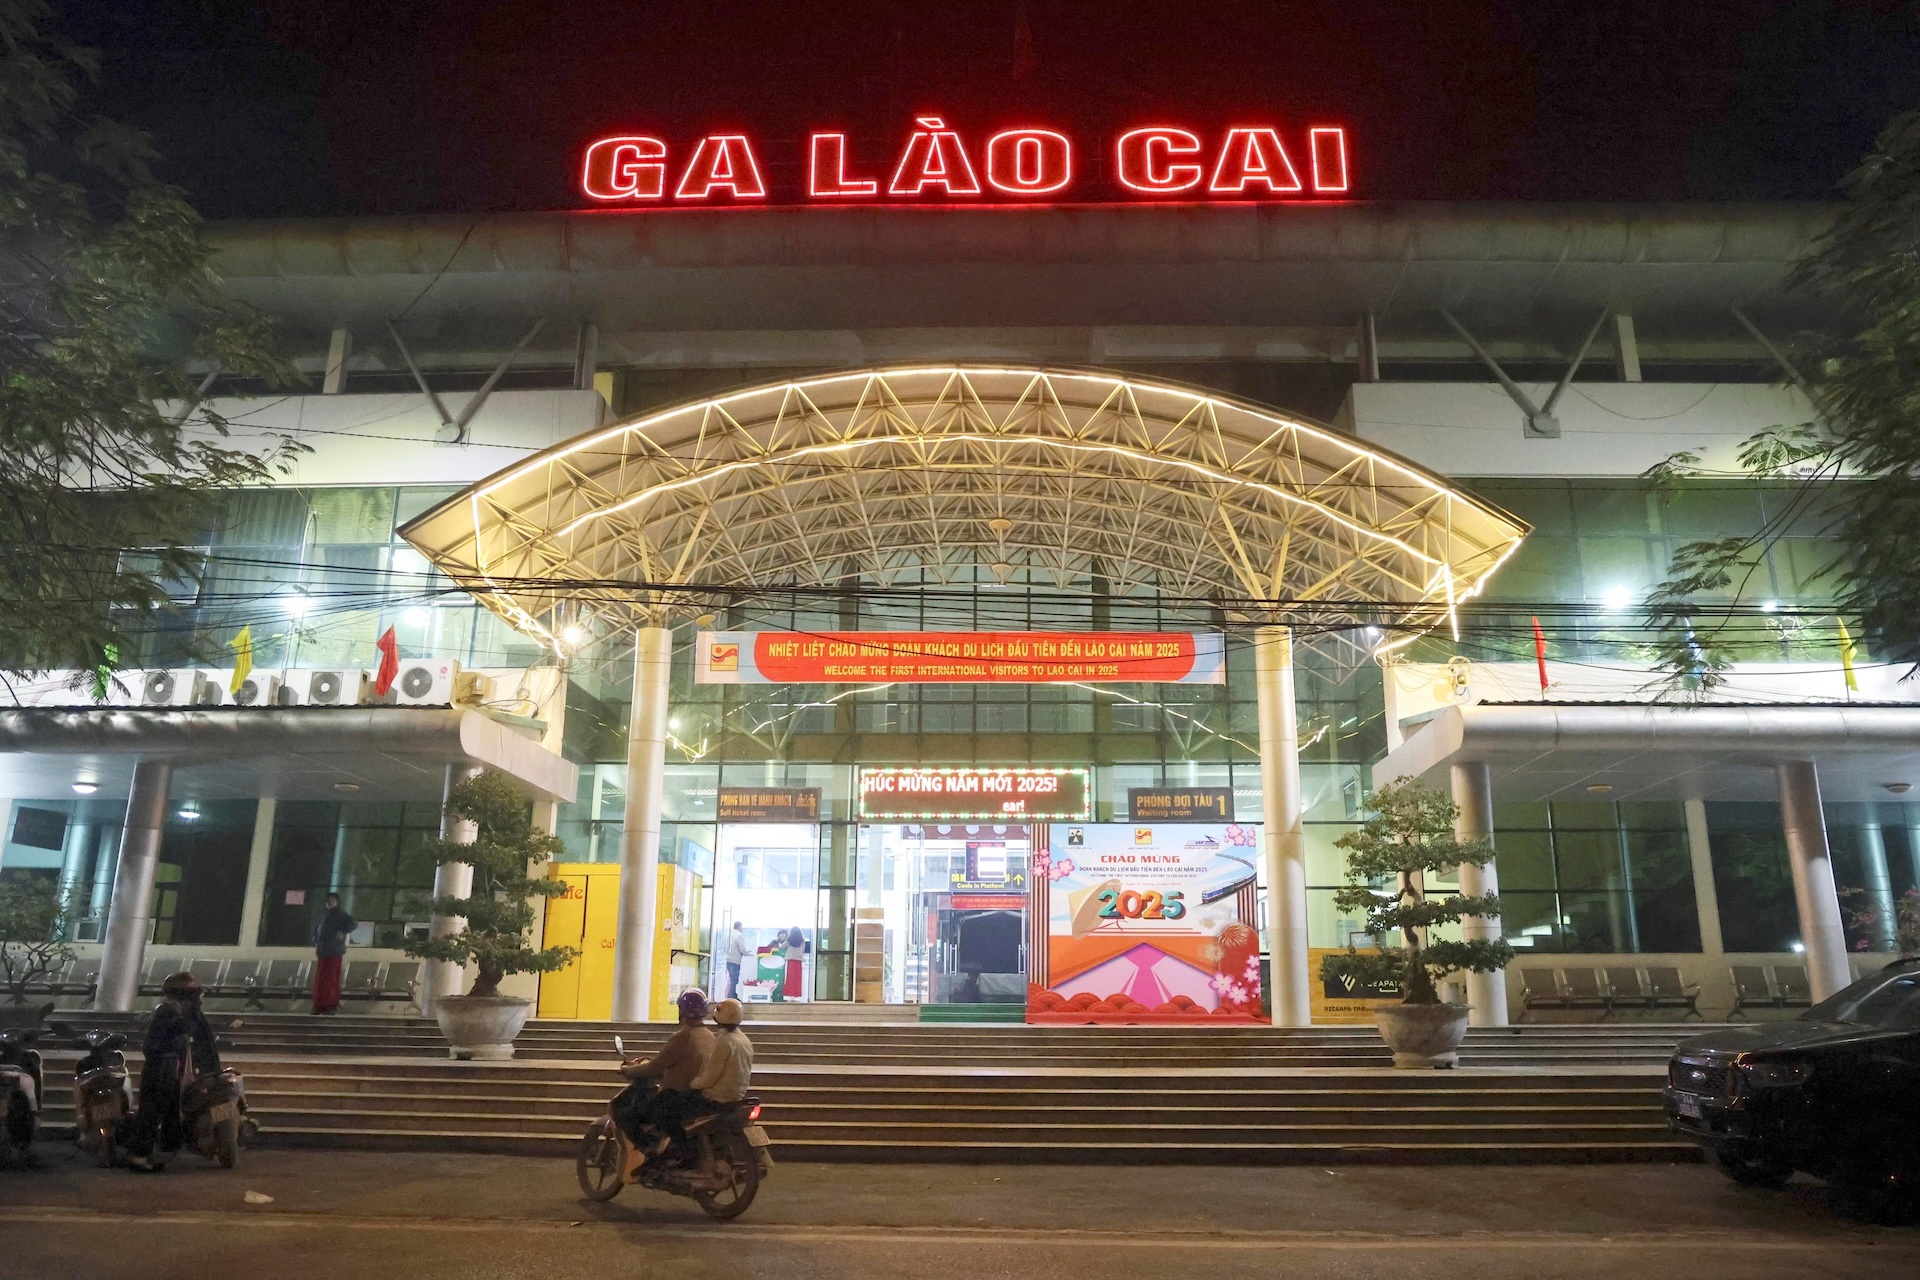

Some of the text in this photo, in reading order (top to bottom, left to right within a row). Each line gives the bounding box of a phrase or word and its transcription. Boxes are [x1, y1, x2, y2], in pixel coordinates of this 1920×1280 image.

[583, 117, 1347, 199] GA LÀO CAI
[768, 640, 799, 661] NHIỆT
[803, 640, 825, 661] LIỆT
[829, 640, 857, 657] CHÀO
[860, 640, 889, 657] MỪNG
[893, 640, 920, 657] ĐOÀN
[925, 639, 960, 657] KHÁCH
[963, 643, 977, 657] DU
[981, 643, 1004, 660] LỊCH
[1033, 640, 1057, 657] TIÊN
[1060, 638, 1081, 657] ĐẾN
[1085, 640, 1106, 657] LÀO
[1109, 643, 1126, 657] CAI
[1130, 640, 1153, 657] NĂM
[1156, 643, 1180, 657] 2025
[824, 665, 1118, 676] WELCOME THE FIRST INTERNATIONAL VISITORS TO LAO CAI IN 2025
[898, 772, 943, 792] MỪNG
[946, 772, 979, 792] NĂM
[982, 772, 1013, 792] MỚI
[1017, 776, 1058, 793] 2025!
[1136, 792, 1213, 810] PHÒNG ĐỢI TÀU
[1216, 795, 1226, 816] 1
[720, 808, 731, 817] Sell
[732, 809, 749, 817] ticket
[1136, 809, 1168, 818] Waiting
[1101, 853, 1181, 863] CHÀO MỪNG
[1098, 890, 1186, 920] 2025
